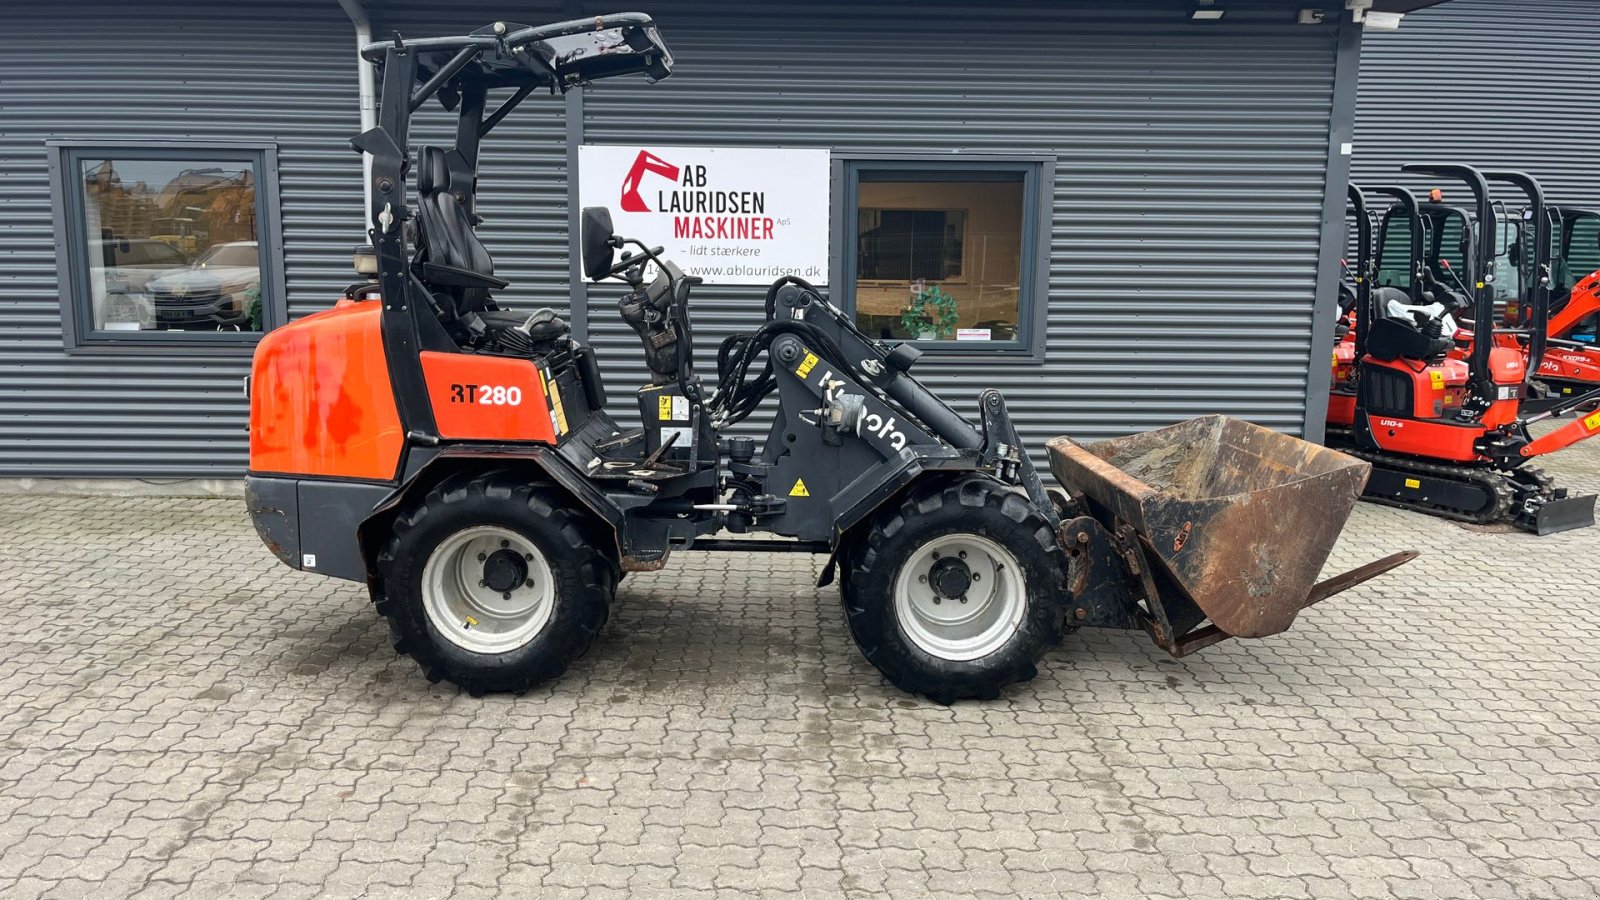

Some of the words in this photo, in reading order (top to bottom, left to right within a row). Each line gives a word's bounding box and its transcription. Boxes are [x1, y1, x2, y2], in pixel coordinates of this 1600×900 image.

[682, 165, 707, 187] AB
[658, 190, 765, 214] LAURIDSEN
[674, 216, 774, 240] MASKINER
[776, 217, 791, 227] ApS
[689, 245, 708, 256] lidt
[710, 245, 761, 257] stærkere
[689, 264, 821, 277] www.ablauridsen.dk
[451, 383, 522, 406] RT280
[818, 370, 906, 452] Kota
